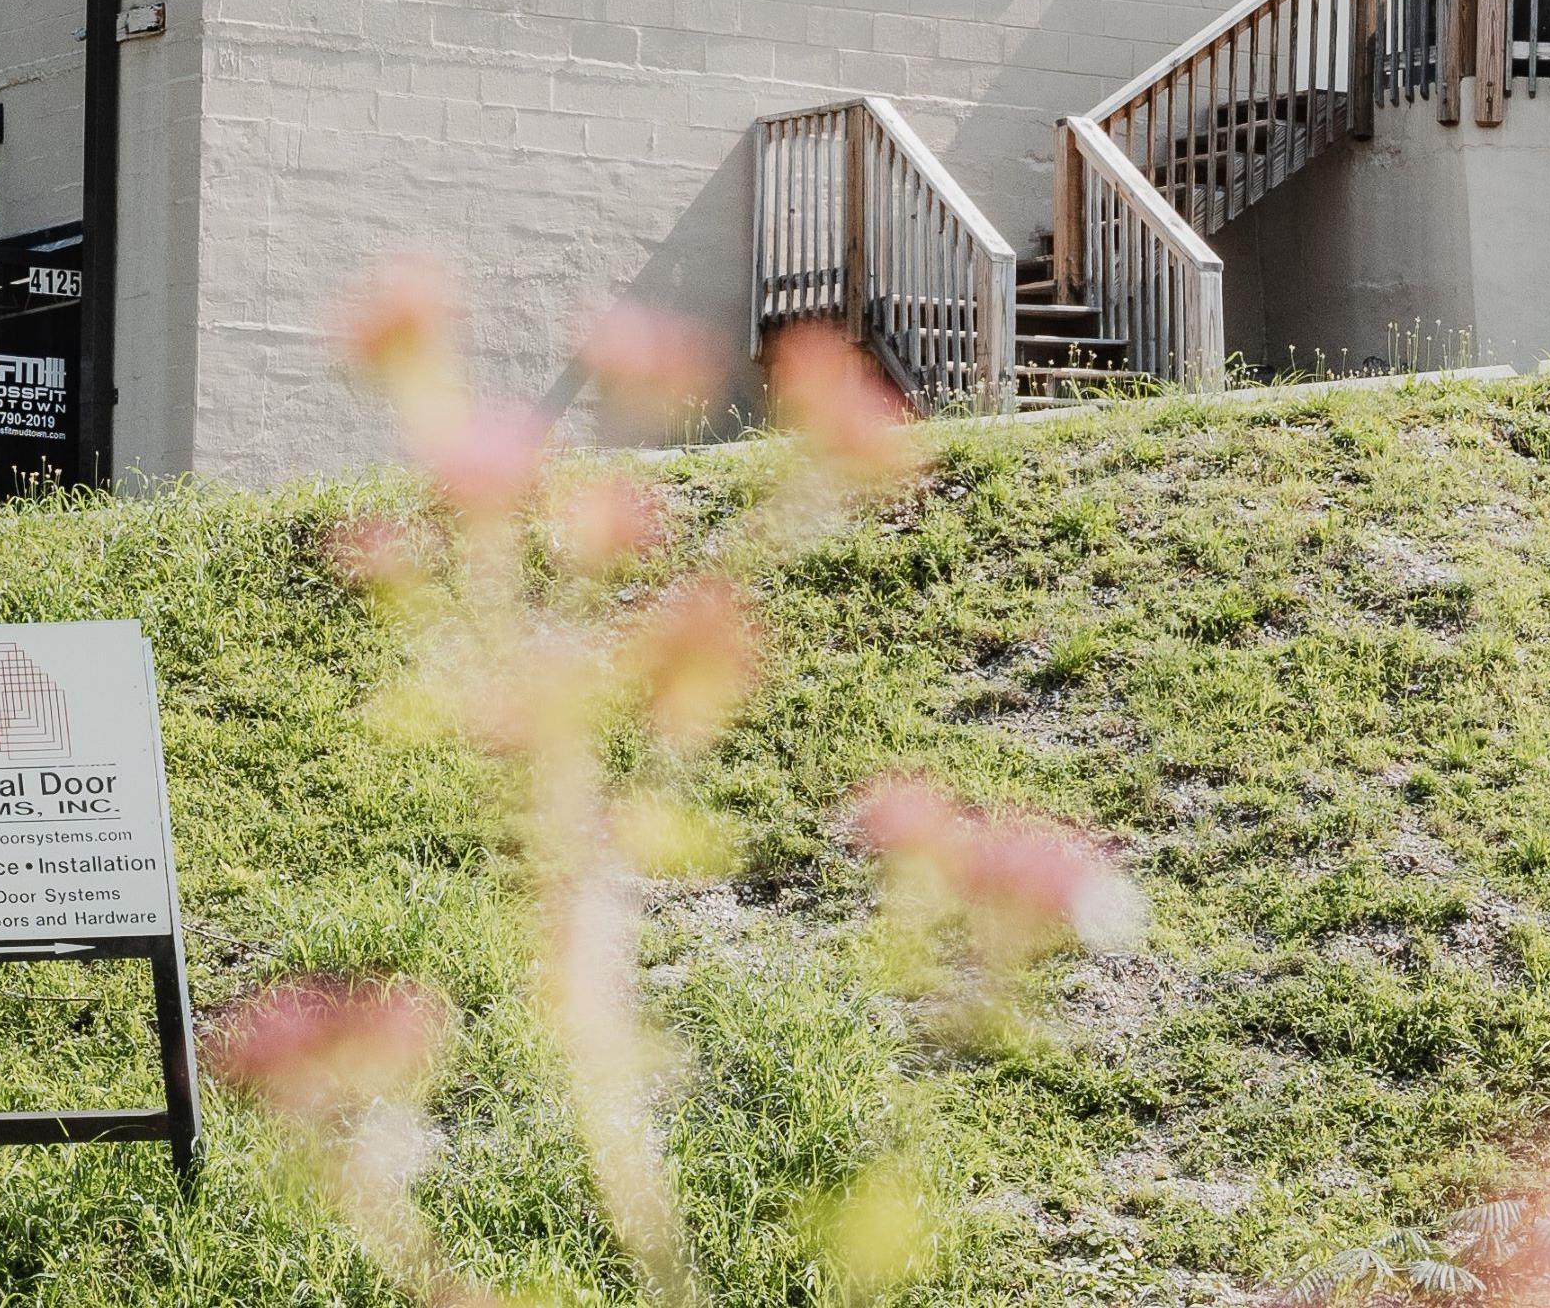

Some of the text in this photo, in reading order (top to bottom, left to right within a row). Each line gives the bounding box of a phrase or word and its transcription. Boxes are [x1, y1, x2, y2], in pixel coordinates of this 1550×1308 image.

[30, 268, 81, 296] 4125
[40, 771, 117, 796] Door
[58, 799, 121, 815] INC.
[38, 855, 157, 875] Installation
[44, 887, 121, 905] Systems
[35, 912, 67, 927] and
[74, 910, 158, 925] Hardware
